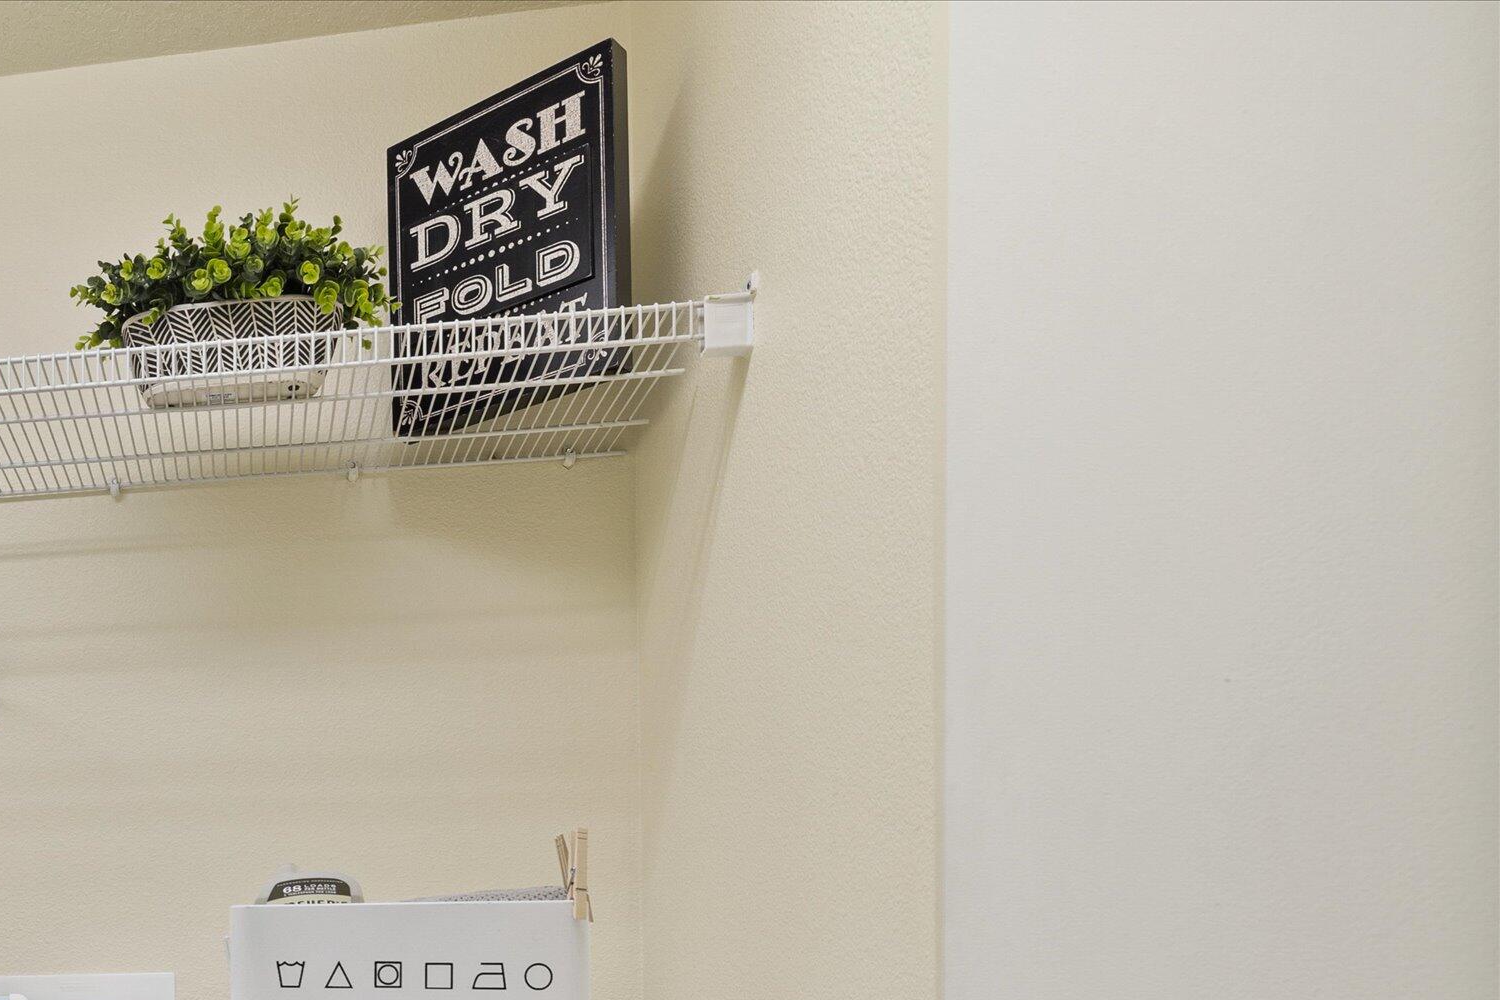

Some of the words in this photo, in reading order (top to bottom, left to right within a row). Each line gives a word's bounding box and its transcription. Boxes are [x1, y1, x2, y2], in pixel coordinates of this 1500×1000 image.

[410, 90, 585, 206] WASH
[410, 153, 585, 273] DRY
[414, 240, 580, 326] FOLD
[282, 884, 302, 894] 68
